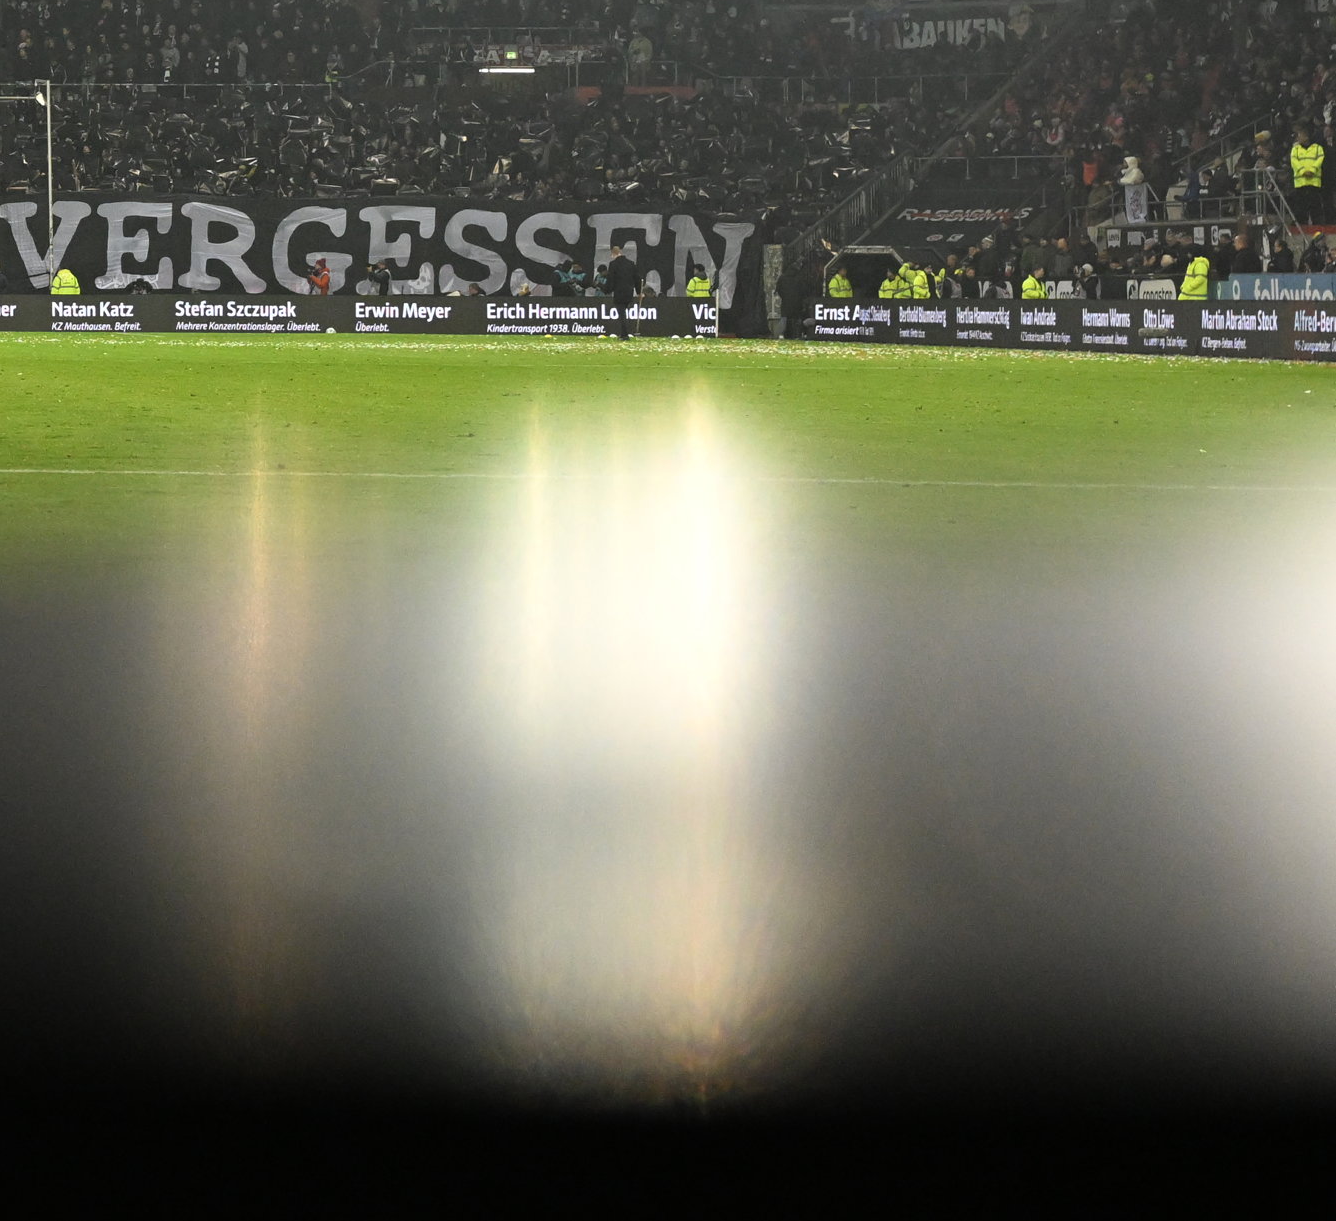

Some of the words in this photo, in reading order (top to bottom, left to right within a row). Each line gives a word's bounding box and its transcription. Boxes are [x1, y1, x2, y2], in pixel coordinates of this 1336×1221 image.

[52, 302, 96, 317] Natan
[100, 302, 133, 316] Katz
[175, 301, 223, 316] Stefan
[227, 301, 296, 320] Szczupak
[356, 302, 399, 318] Erwin
[403, 303, 451, 322] Meyer
[487, 303, 525, 319] Erich
[529, 304, 597, 319] Hermann
[815, 304, 850, 320] Ernst
[899, 306, 918, 322] Berthold
[1034, 308, 1056, 325] Andrade
[1083, 308, 1108, 326] Hermann
[1110, 309, 1130, 327] Worms
[52, 322, 63, 330] KZ
[64, 322, 112, 330] Mauthausen.
[115, 322, 141, 332] Befreit.
[1144, 309, 1157, 329] Otto
[1157, 309, 1174, 329] Löwe
[1202, 310, 1224, 329] Martin
[1226, 310, 1256, 330] Abraham
[176, 322, 207, 330] Mehrere
[209, 322, 284, 332] Konzentrationslager.
[287, 324, 321, 333] Überlebt.
[355, 324, 389, 333] Überlebt.
[487, 324, 547, 334] Kindertransport
[550, 324, 569, 332] 1938.
[572, 323, 605, 333] Überlebt.
[815, 325, 834, 335] Firma
[835, 325, 859, 336] arisiert
